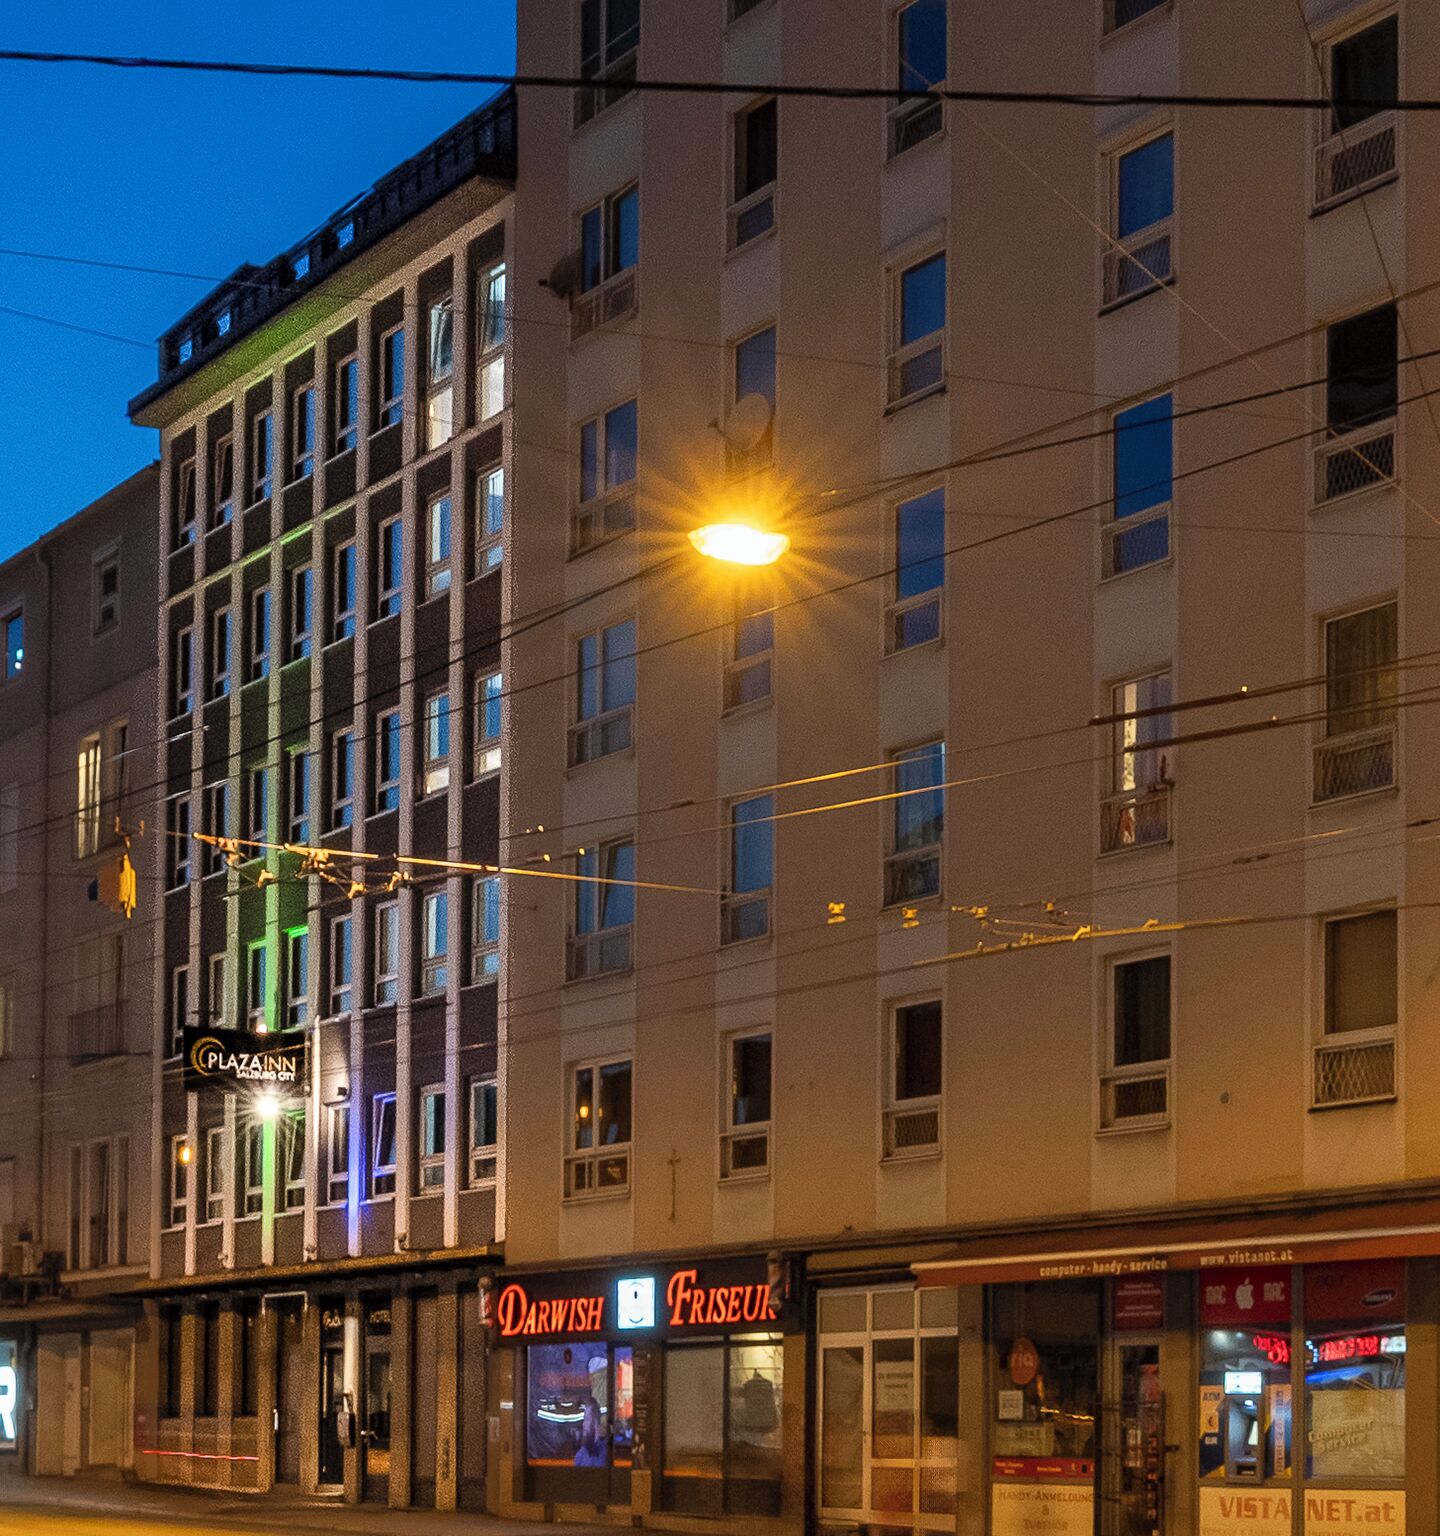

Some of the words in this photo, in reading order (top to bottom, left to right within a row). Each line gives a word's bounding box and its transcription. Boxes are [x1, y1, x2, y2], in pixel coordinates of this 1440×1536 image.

[208, 1052, 262, 1071] PLAZA
[264, 1055, 296, 1072] INN
[1040, 1264, 1086, 1278] computer
[1092, 1260, 1122, 1275] handy
[1129, 1257, 1168, 1271] service
[1200, 1249, 1293, 1266] www.vistanet.at
[498, 1284, 604, 1336] DARWISH
[667, 1269, 777, 1326] FRISEUR
[1219, 1496, 1290, 1519] VISTA
[1307, 1499, 1396, 1523] NET.at
